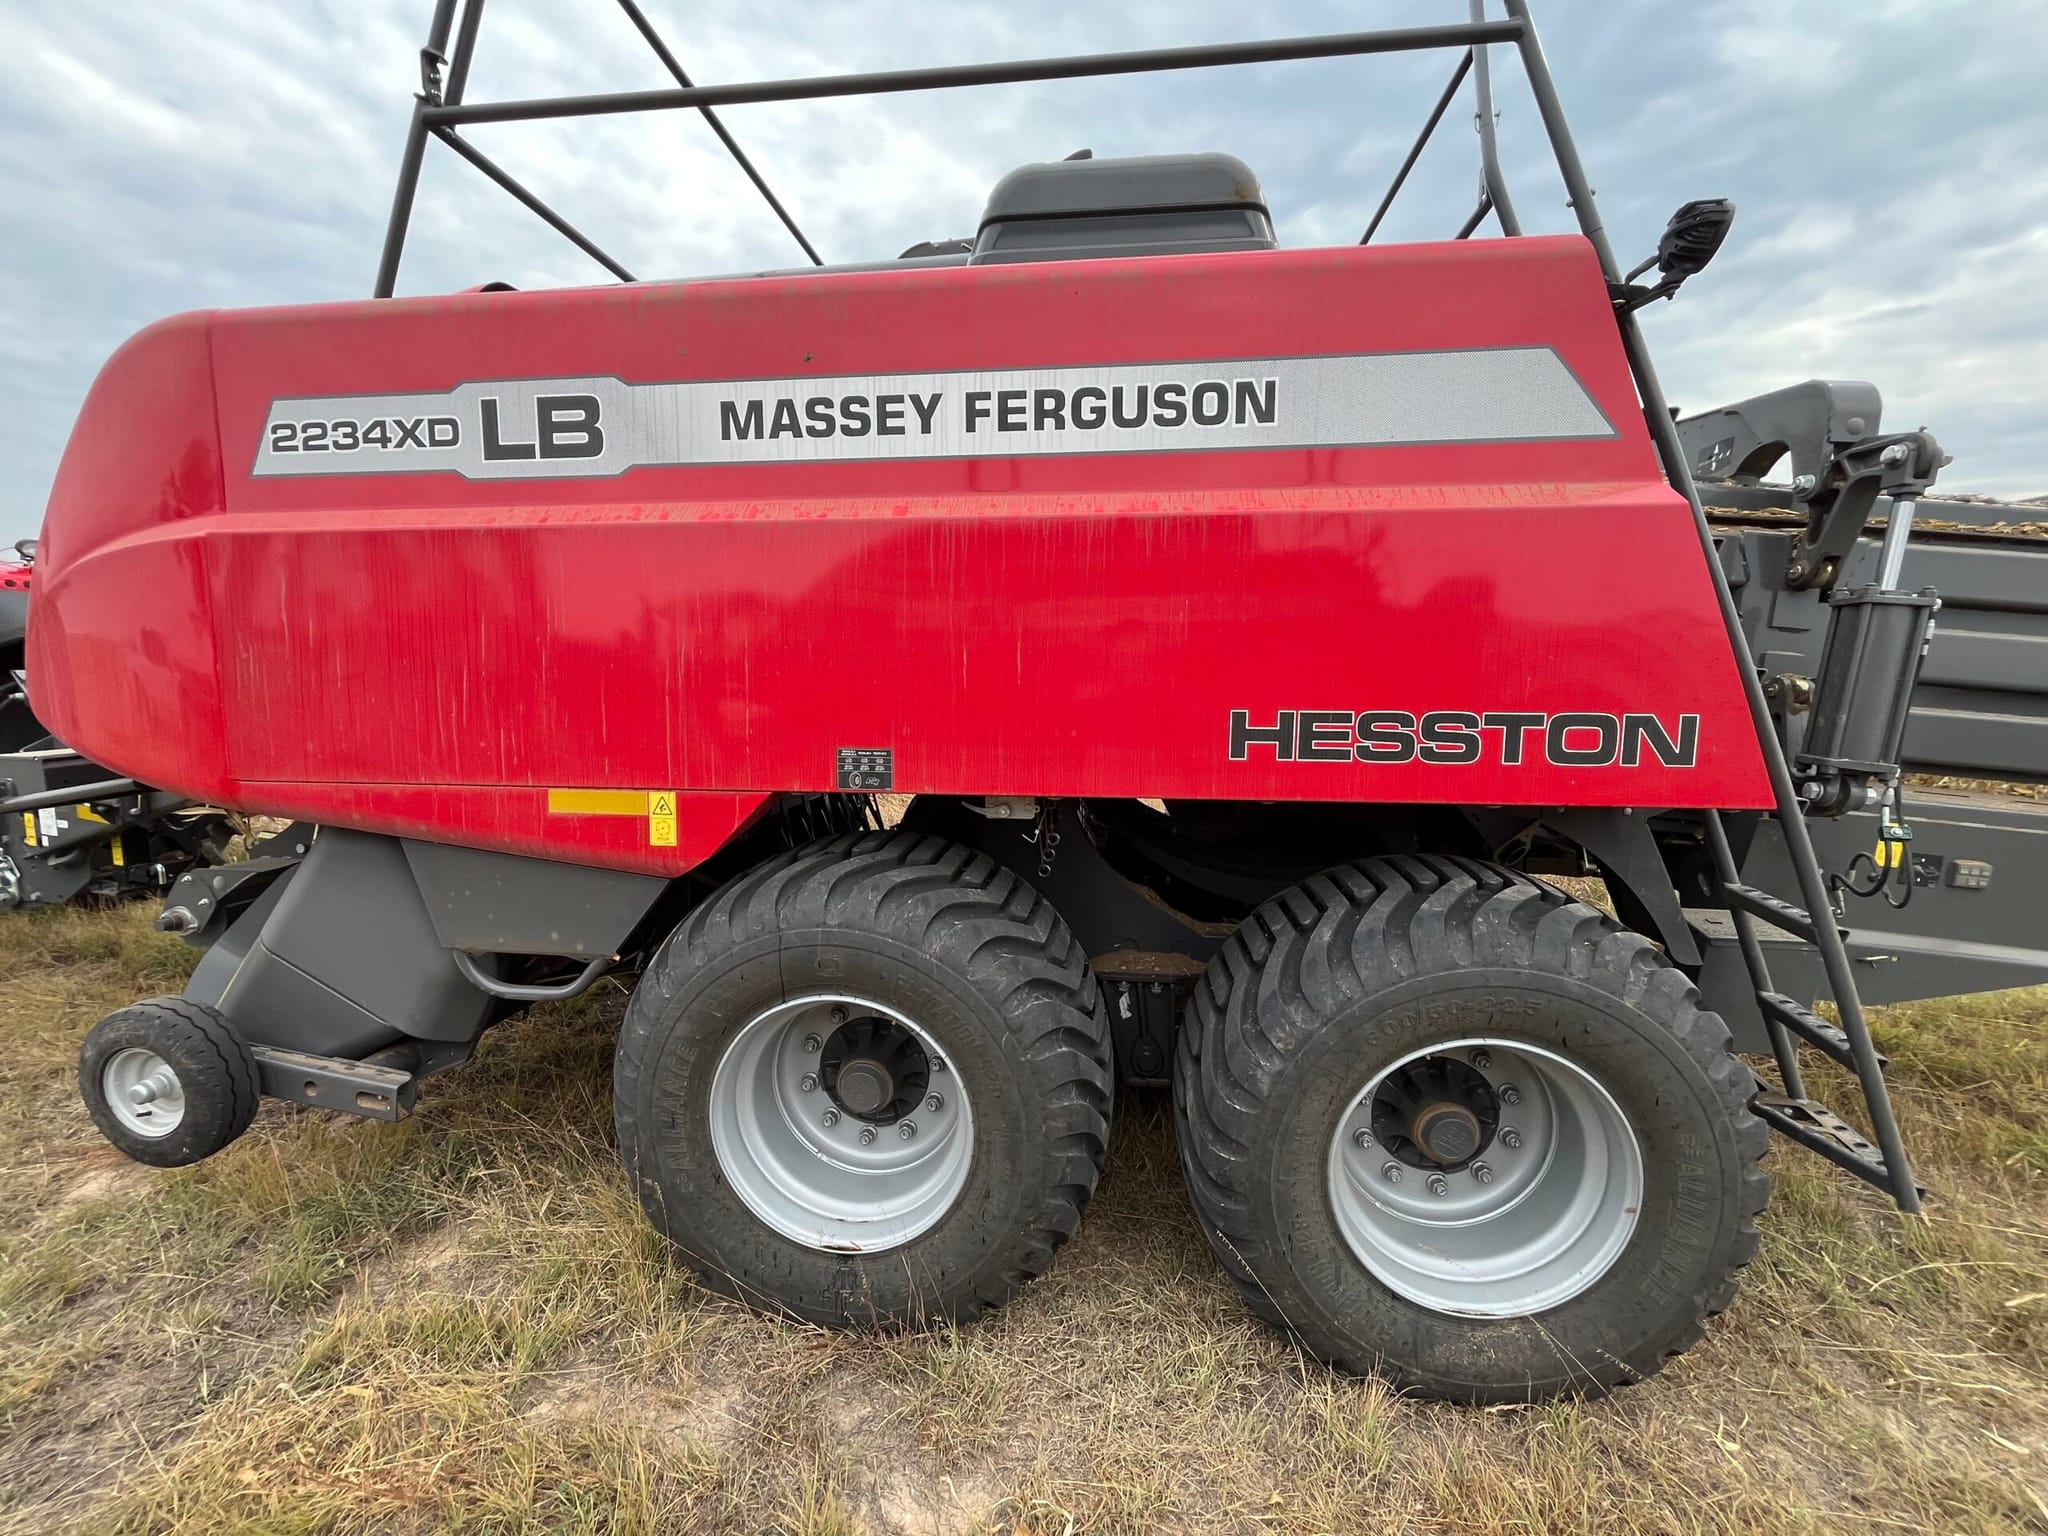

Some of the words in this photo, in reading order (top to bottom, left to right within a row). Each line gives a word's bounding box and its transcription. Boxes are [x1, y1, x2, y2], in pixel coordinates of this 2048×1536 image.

[268, 414, 461, 453] 2234XD
[478, 393, 605, 462] LB
[719, 392, 943, 442] MASSEY
[964, 379, 1278, 433] FERGUSON
[1228, 709, 1700, 768] HESSTON
[660, 1038, 697, 1171] ALLIANCE
[1640, 1158, 1709, 1306] ALLIANCE
